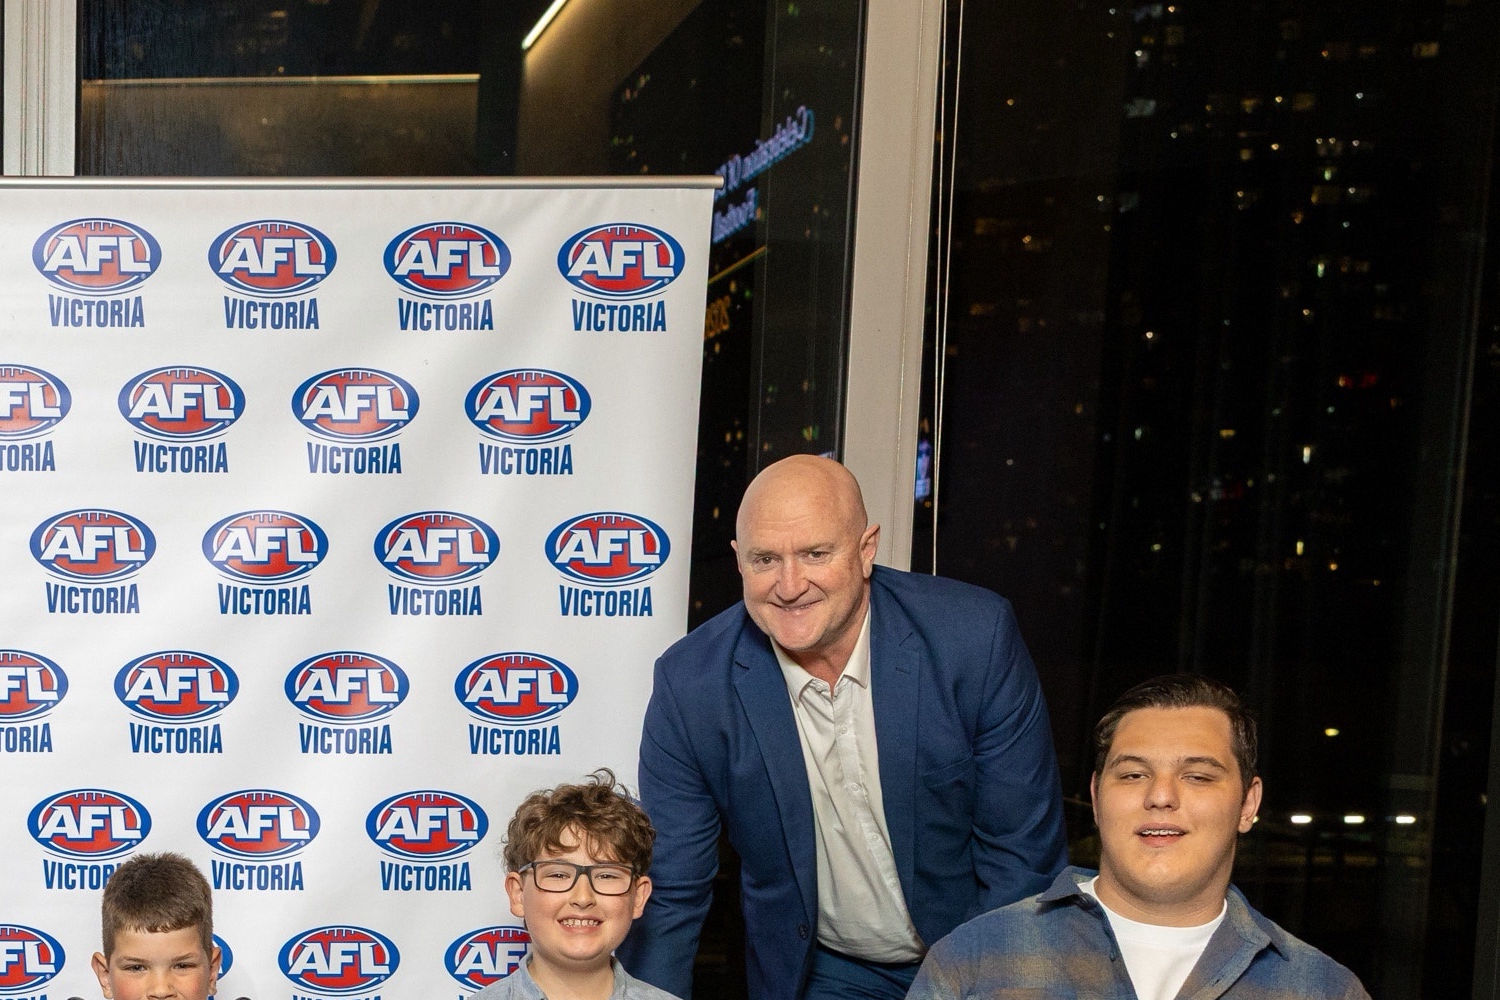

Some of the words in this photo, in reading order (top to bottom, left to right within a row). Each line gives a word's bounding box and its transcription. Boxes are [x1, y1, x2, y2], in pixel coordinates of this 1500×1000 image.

[44, 236, 151, 272] AFL
[219, 239, 327, 275] AFL
[394, 241, 501, 277] AFL
[568, 242, 675, 278] AFL
[50, 295, 143, 327] VICTORIA
[224, 297, 318, 329] VICTORIA
[398, 298, 493, 330] VICTORIA
[572, 300, 666, 332] VICTORIA
[129, 384, 235, 419] AFL
[303, 386, 410, 421] AFL
[475, 387, 581, 422] AFL
[134, 441, 227, 473] VICTORIA
[308, 443, 401, 474] VICTORIA
[479, 443, 572, 475] VICTORIA
[41, 527, 146, 562] AFL
[213, 529, 319, 563] AFL
[385, 529, 490, 564] AFL
[556, 530, 661, 565] AFL
[46, 582, 139, 613] VICTORIA
[218, 584, 311, 615] VICTORIA
[389, 584, 482, 615] VICTORIA
[560, 585, 652, 616] VICTORIA
[125, 668, 230, 702] AFL
[295, 669, 400, 703] AFL
[465, 670, 570, 704] AFL
[130, 722, 222, 753] VICTORIA
[299, 723, 392, 754] VICTORIA
[469, 724, 560, 755] VICTORIA
[38, 806, 142, 839] AFL
[207, 806, 311, 839] AFL
[377, 807, 480, 840] AFL
[212, 860, 303, 890] VICTORIA
[381, 861, 471, 891] VICTORIA
[289, 942, 391, 975] AFL
[454, 942, 527, 975] AF
